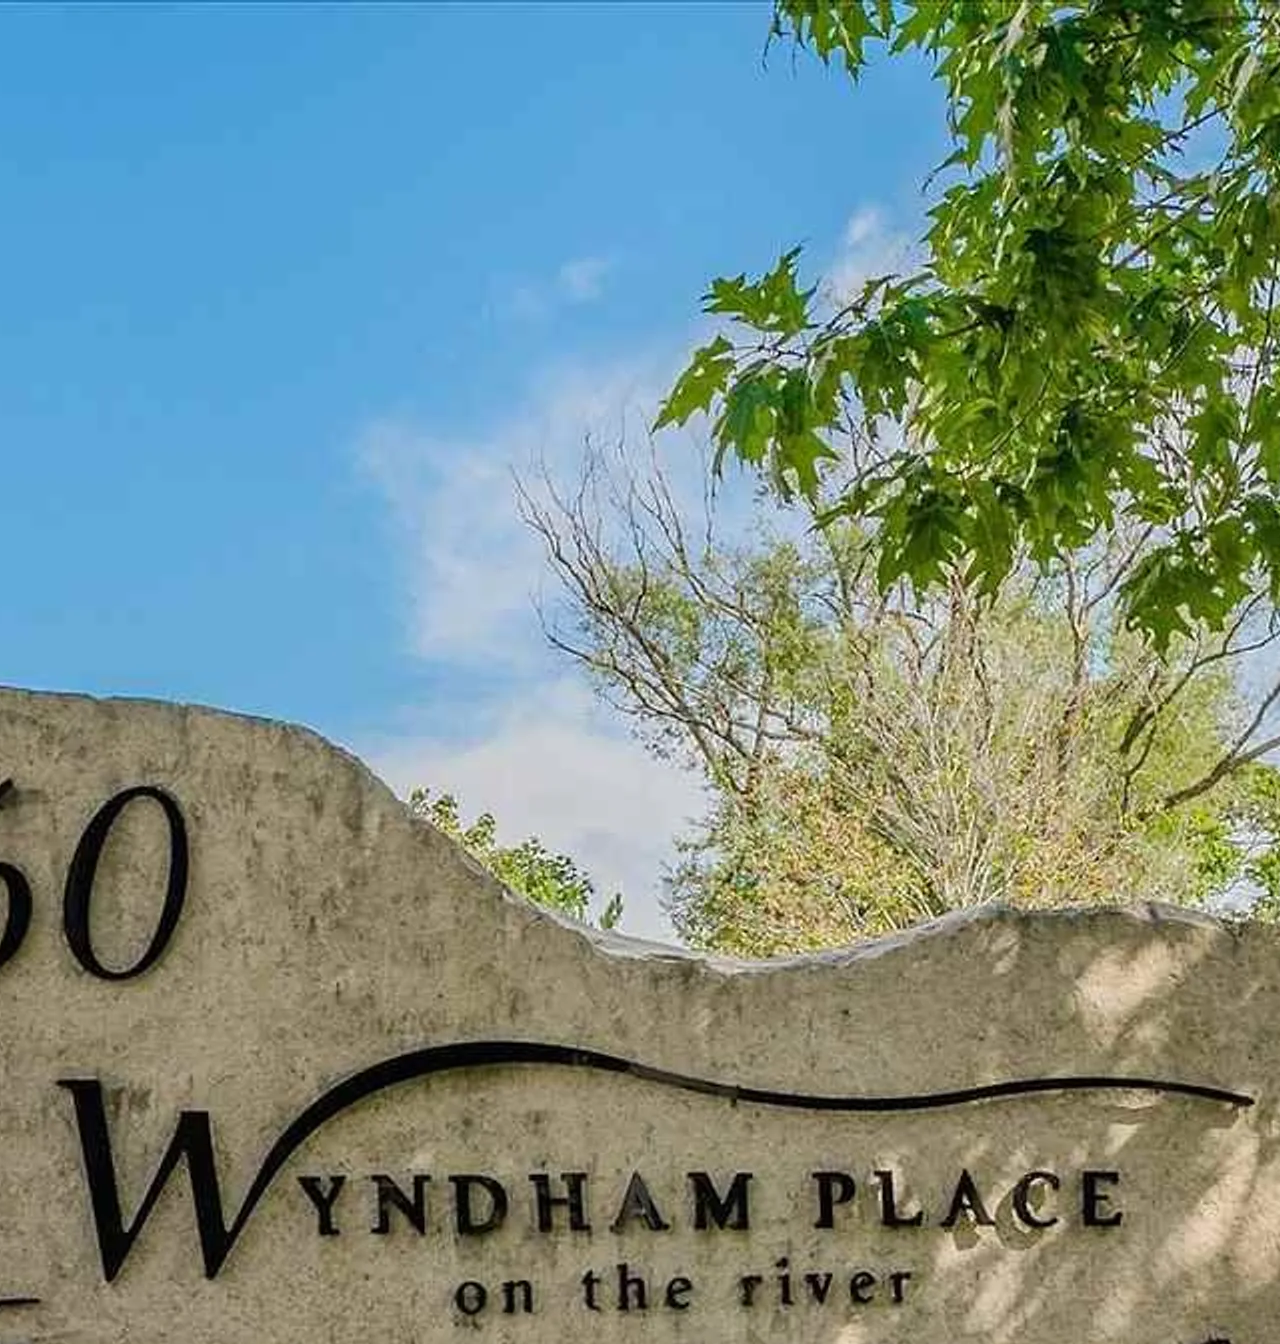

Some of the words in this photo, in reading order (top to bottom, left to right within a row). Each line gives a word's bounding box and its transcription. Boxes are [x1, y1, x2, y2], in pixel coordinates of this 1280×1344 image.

[56, 1078, 754, 1283] WYNDHAM
[812, 1170, 1123, 1230] PLACE
[454, 1277, 535, 1316] on
[583, 1264, 693, 1311] the
[741, 1257, 915, 1308] river
